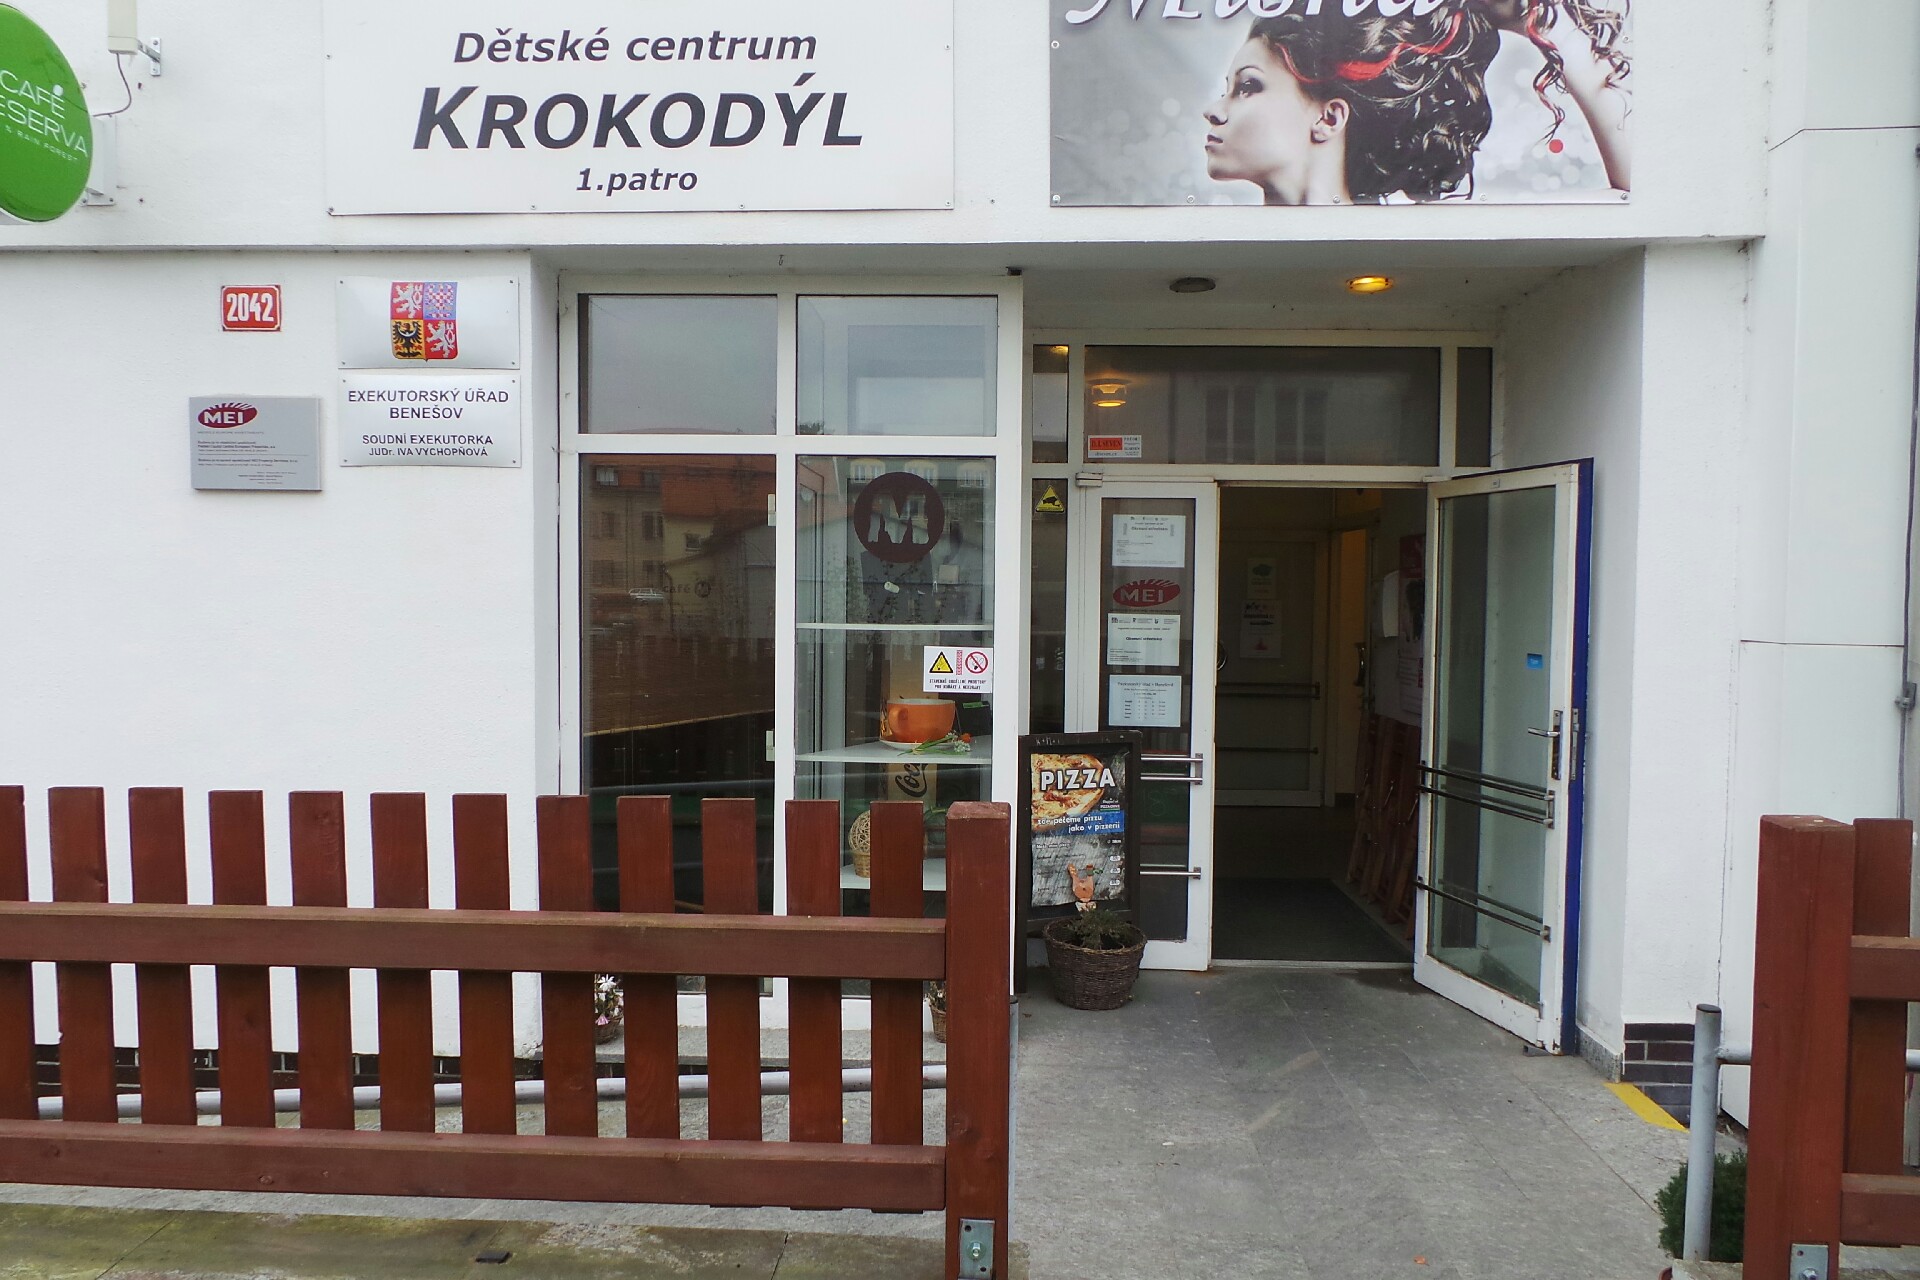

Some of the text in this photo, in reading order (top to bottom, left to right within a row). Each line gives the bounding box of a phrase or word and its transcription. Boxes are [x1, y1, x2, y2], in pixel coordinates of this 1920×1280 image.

[453, 27, 817, 63] Dětské centrum
[413, 72, 863, 150] KROKODÝL
[576, 168, 698, 197] 1.patro
[226, 293, 275, 322] 2042
[348, 387, 509, 403] EXEKUTORSKÝ ÚŘAD
[203, 411, 245, 424] MEI
[389, 404, 464, 419] BENEŠOV
[362, 432, 493, 445] SOUDNÍ EXEKUTORKA
[368, 447, 395, 456] JUDr.
[397, 447, 414, 456] IVA
[1120, 588, 1164, 603] MEI
[1040, 768, 1116, 791] PIZZA
[1083, 815, 1103, 823] pizzu
[1068, 824, 1085, 834] jako
[1094, 822, 1120, 832] pizzerii
